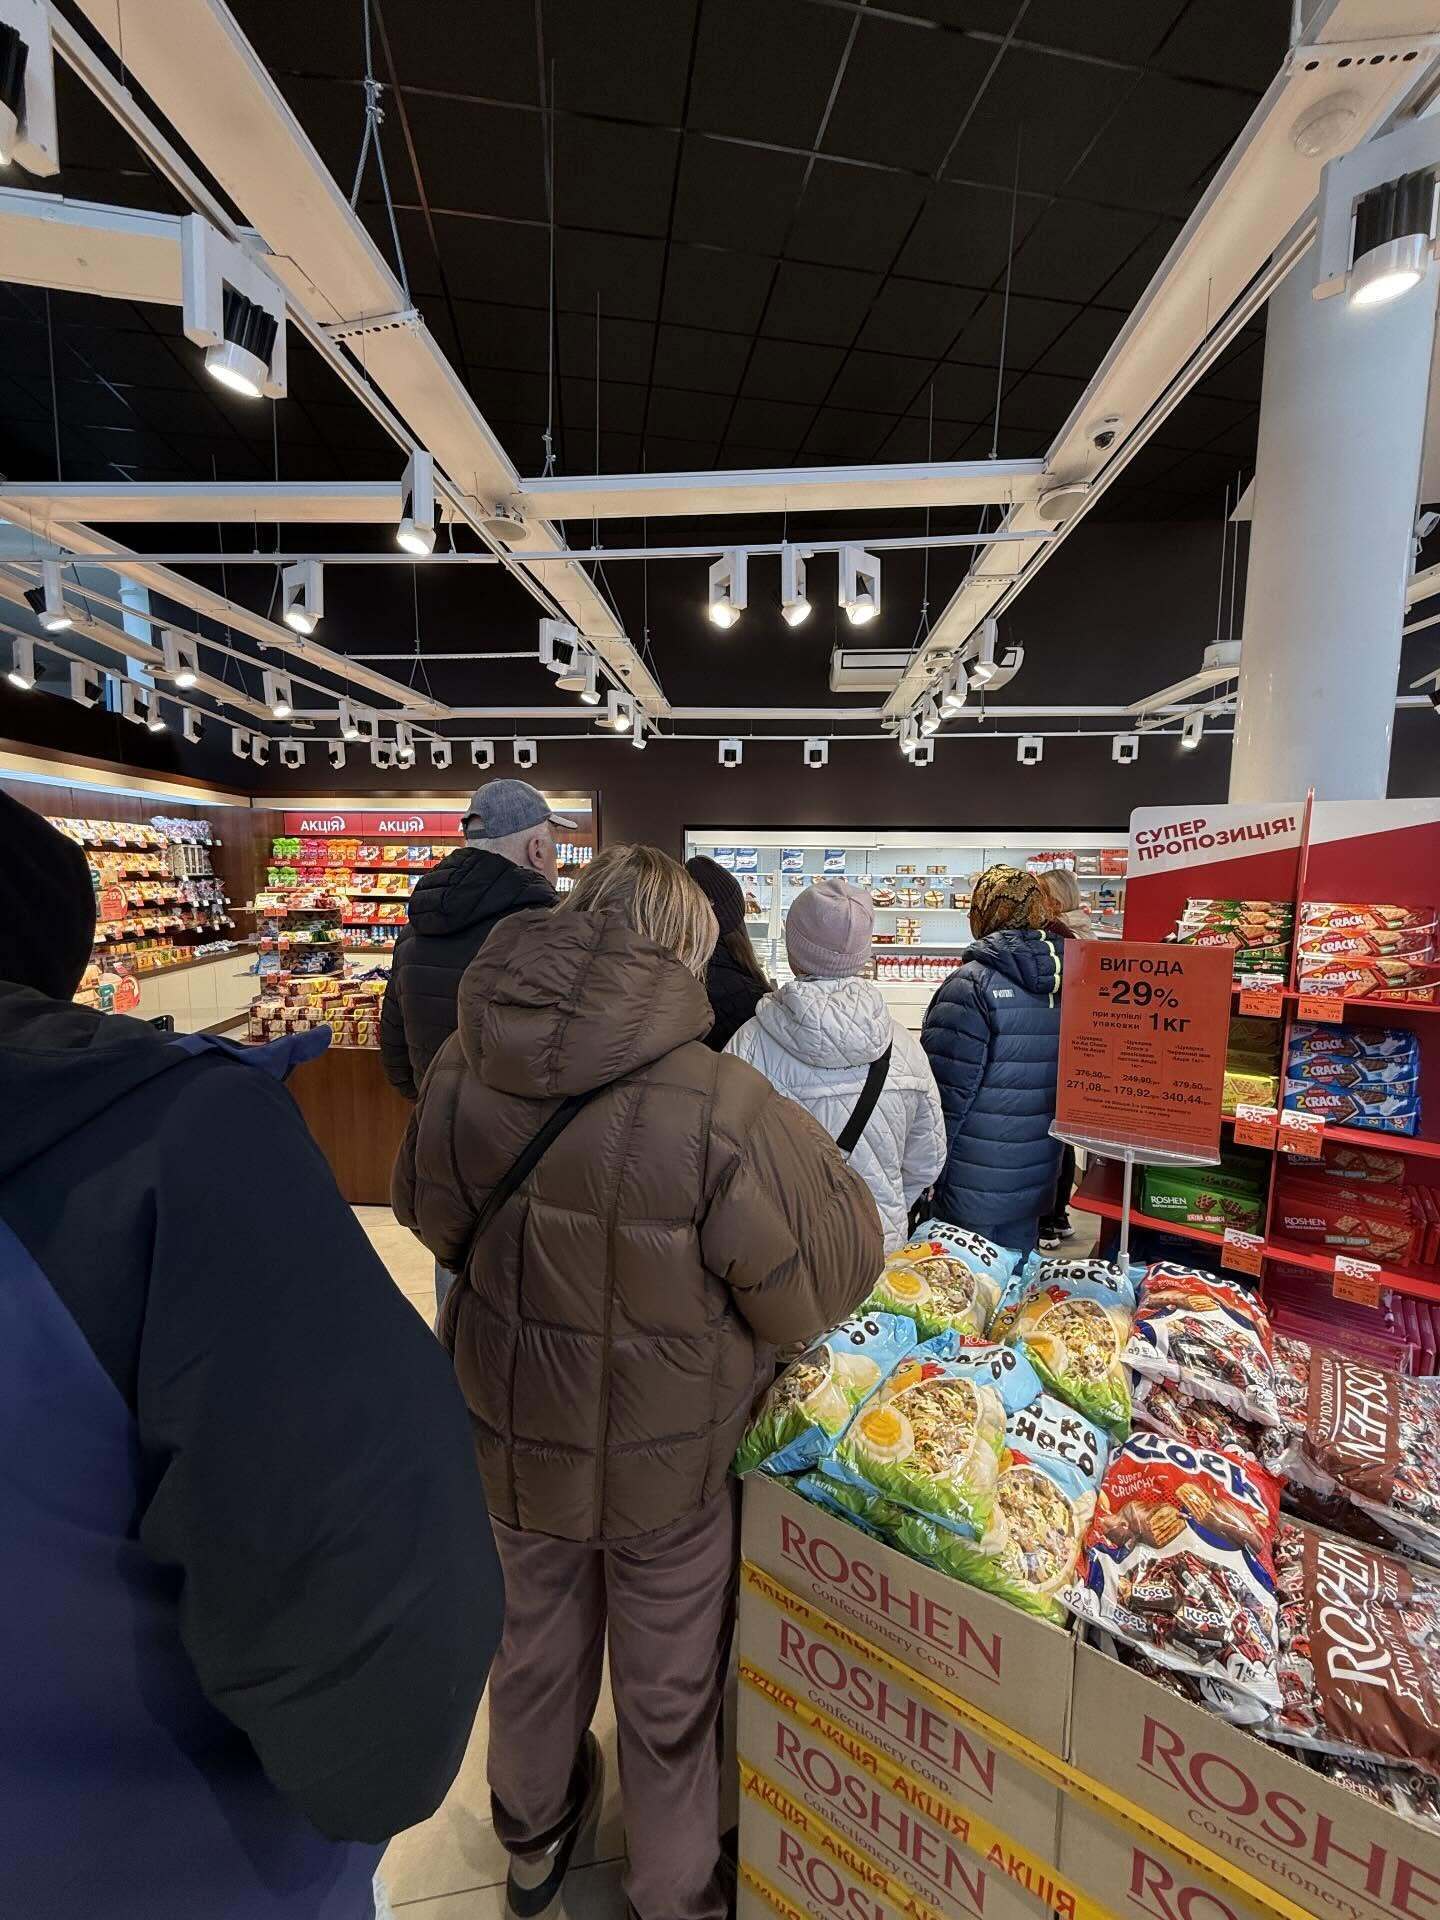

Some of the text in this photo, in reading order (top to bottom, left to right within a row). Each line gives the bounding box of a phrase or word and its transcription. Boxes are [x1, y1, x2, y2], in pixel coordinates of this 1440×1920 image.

[300, 820, 341, 832] АКЦІЯ
[378, 820, 419, 832] АКЦІЯ
[1136, 819, 1206, 844] СУПЕР
[1138, 817, 1296, 861] ПРОПОЗИЦІЯ!
[1100, 958, 1184, 976] ВИГОДА
[1099, 980, 1178, 1008] -29%
[1092, 1010, 1142, 1020] при купівлі
[1092, 1021, 1140, 1030] упаковки
[1066, 1080, 1101, 1092] 271,08
[1114, 1086, 1151, 1098] 179,92
[1162, 1092, 1201, 1104] 340,44
[1242, 1110, 1272, 1125] -35%
[1286, 1118, 1318, 1133] -35%
[1150, 1196, 1187, 1205] ROSHEN
[1284, 1216, 1326, 1226] ROSHEN
[928, 1231, 992, 1266] CHOCO
[930, 1223, 998, 1260] KO-KO
[1229, 1236, 1258, 1252] -35%
[1040, 1268, 1118, 1292] CHOCO
[1340, 1264, 1374, 1282] -35%
[1318, 1384, 1334, 1438] CHOCOLATE
[1336, 1363, 1388, 1464] OSHEN
[1006, 1416, 1094, 1477] HOCO
[1111, 1476, 1156, 1498] CRUNCHY
[1117, 1472, 1142, 1484] SUPER
[781, 1514, 1002, 1678] ROSHEN
[1316, 1542, 1392, 1689] ROSHEN
[812, 1583, 958, 1679] Confectionery Corp.
[780, 1619, 996, 1795] ROSHEN
[808, 1690, 952, 1795] Confectionery Corp.
[776, 1721, 986, 1914] ROSHEN
[811, 1716, 878, 1774] АКЦІЯ
[893, 1776, 970, 1842] АКЦІЯ
[986, 1843, 1076, 1920] АКЦІЯ
[747, 1775, 889, 1895] АКЦІЯ АКЦІЯ
[804, 1792, 944, 1911] Confectionery Corp.
[1188, 1809, 1363, 1920] Confectionery
